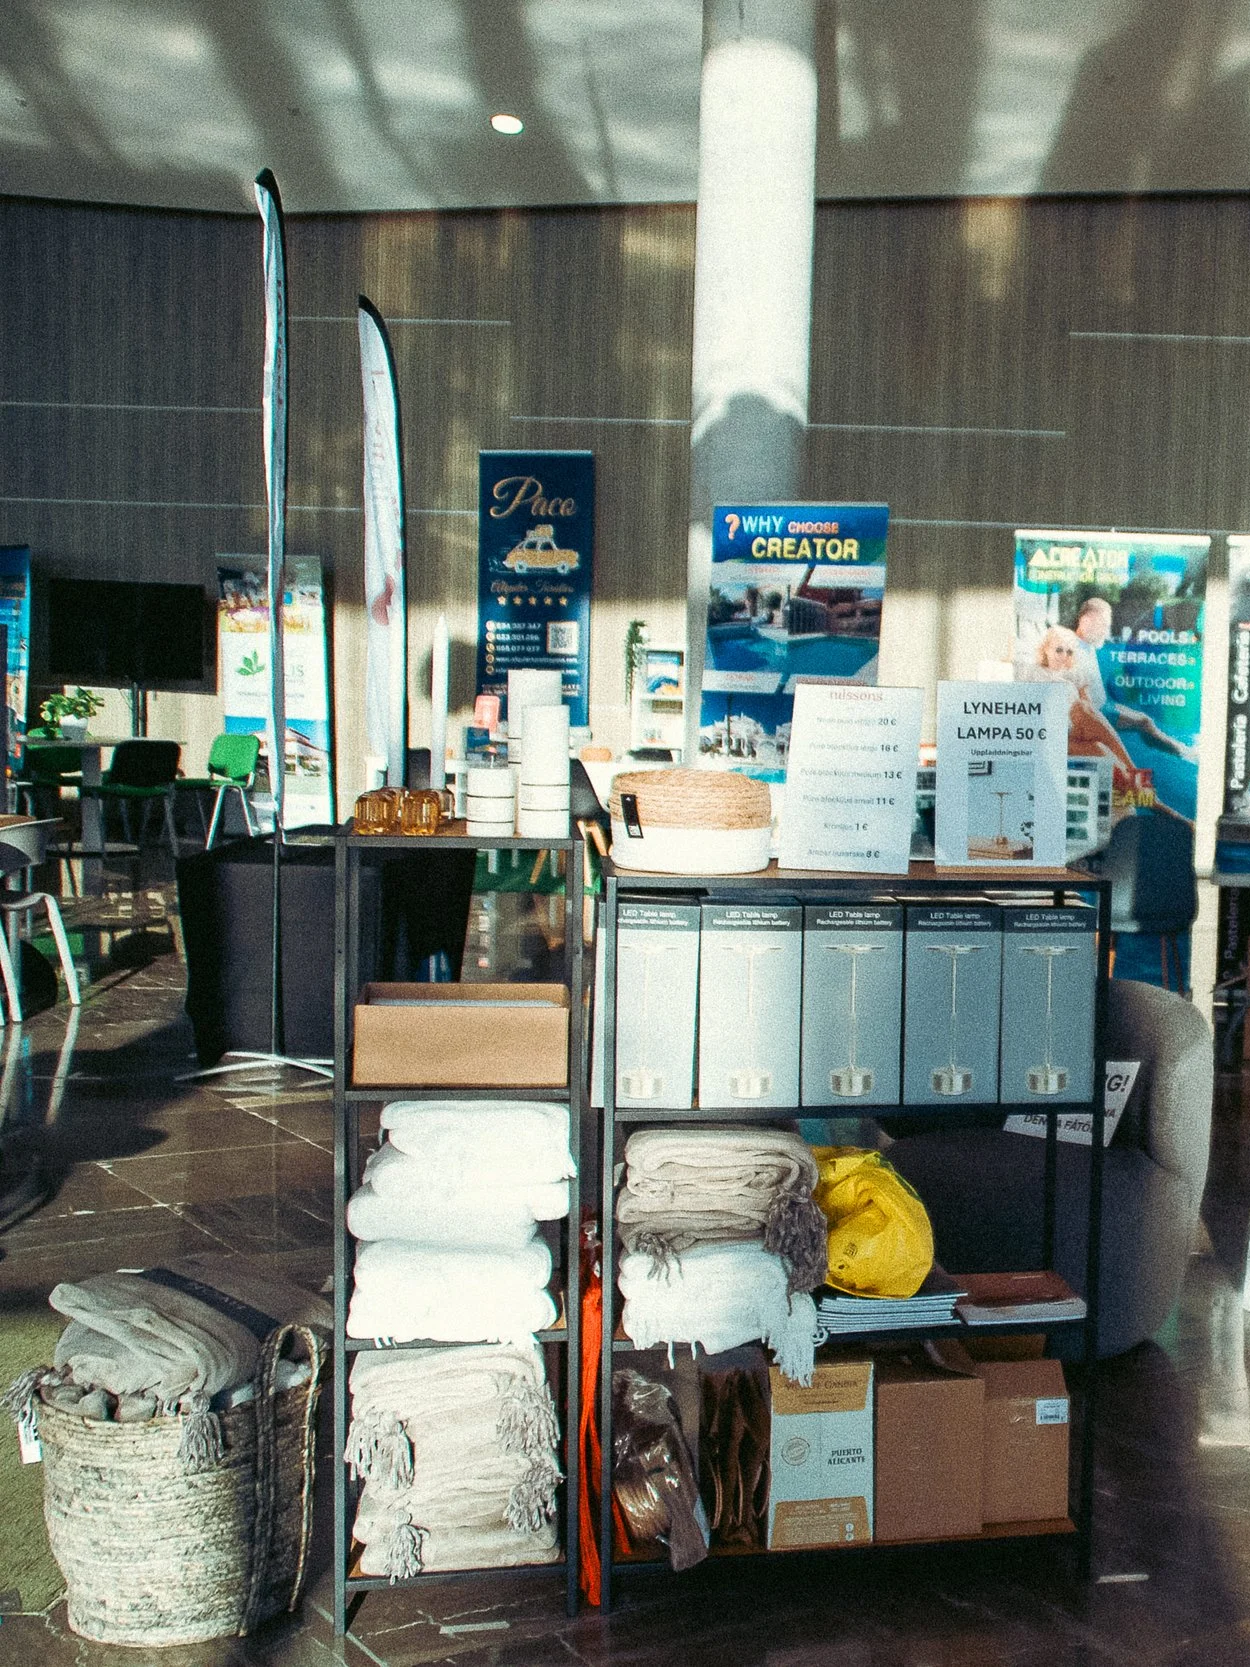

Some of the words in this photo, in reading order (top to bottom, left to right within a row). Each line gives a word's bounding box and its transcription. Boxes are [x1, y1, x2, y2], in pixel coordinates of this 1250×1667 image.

[490, 476, 577, 518] Paco
[742, 515, 783, 533] WHY
[788, 521, 839, 534] CHOOSE
[751, 537, 859, 560] CREATOR
[1137, 630, 1189, 644] POOLS
[1110, 651, 1187, 665] TERRACES
[1114, 676, 1187, 690] OUTDOOR
[1139, 694, 1187, 707] LIVING
[963, 702, 1042, 715] LYNEHAM
[957, 727, 1012, 740] LAMPA
[1015, 728, 1034, 740] 50
[1038, 728, 1047, 740] €
[876, 796, 887, 806] 11
[1113, 789, 1154, 807] EAM
[828, 911, 843, 919] LED
[845, 911, 863, 919] Table
[864, 912, 880, 920] lamp
[1026, 913, 1040, 921] LED
[1107, 1075, 1130, 1092] G!
[1024, 1115, 1061, 1128] DENA
[1064, 1119, 1092, 1132] FÅTÖ
[831, 1448, 863, 1458] PUERTO
[827, 1456, 865, 1466] ALICANTE
